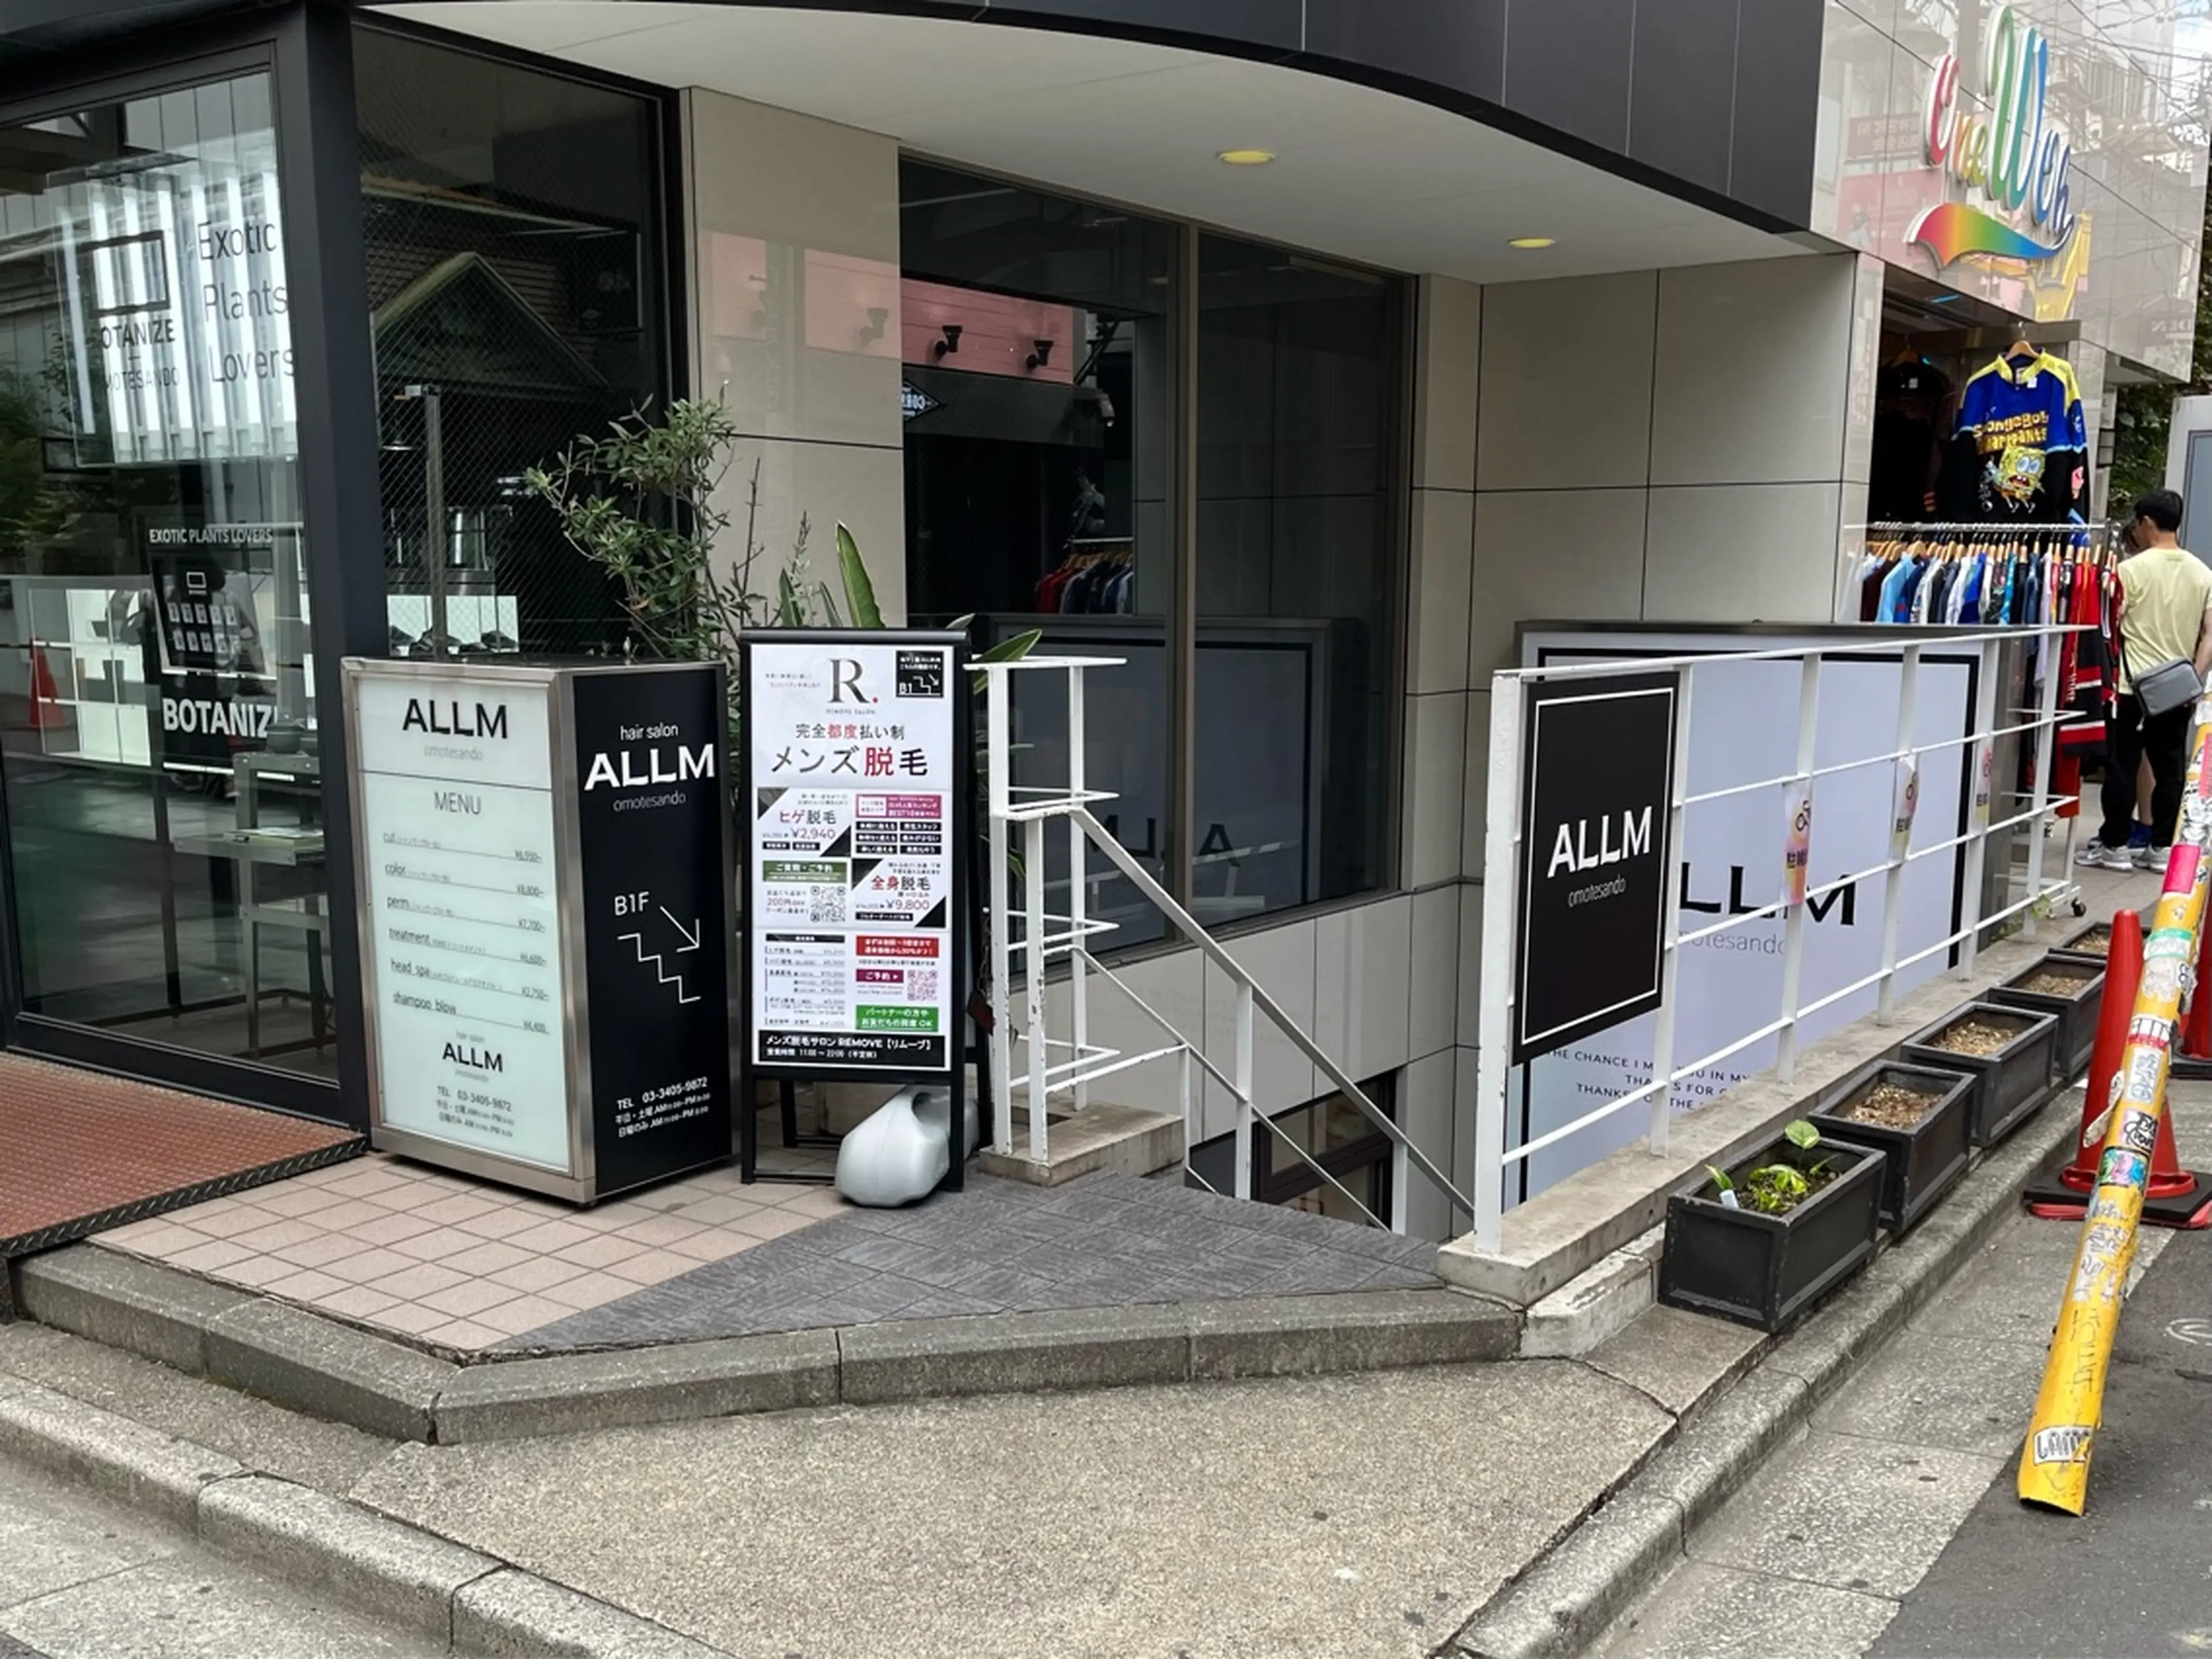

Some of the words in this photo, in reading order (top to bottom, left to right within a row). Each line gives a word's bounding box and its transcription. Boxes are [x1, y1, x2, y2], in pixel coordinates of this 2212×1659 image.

[198, 221, 276, 260] Exotic
[204, 281, 287, 321] Plants
[100, 320, 176, 349] OTANIZE
[209, 344, 294, 382] Lovers
[149, 529, 187, 543] EXOTIC
[188, 529, 229, 543] PLANTS
[231, 529, 273, 543] LOVERS
[899, 682, 912, 694] B1
[162, 698, 278, 738] BOTANIZ
[403, 698, 507, 739] ALLM
[620, 724, 644, 741] hair
[646, 722, 679, 738] salon
[796, 723, 906, 740] 完全都度払い制
[584, 743, 715, 791] ALLM
[771, 745, 928, 777] メンズ脱毛
[434, 791, 481, 815] MENU
[613, 790, 686, 812] omotesando
[780, 809, 836, 825] ヒゲ脱毛
[790, 827, 836, 840] ¥2,940
[1547, 806, 1652, 878] ALLM
[385, 863, 406, 876] color
[871, 874, 931, 891] 全身脱毛
[1568, 874, 1626, 907] omotesando
[387, 896, 410, 909] perm
[614, 891, 649, 915] B1F
[886, 899, 930, 911] ¥9,800
[389, 927, 430, 944] treatment
[391, 958, 412, 974] head
[415, 964, 431, 978] spa
[393, 991, 432, 1010] shampoo
[434, 999, 457, 1014] blow
[766, 1035, 836, 1047] メンズ脱毛サロン
[838, 1037, 883, 1048] REMOVE
[442, 1041, 503, 1073] ALLM
[1574, 1051, 1629, 1068] CHANCE
[1711, 1070, 1725, 1081] IN
[1686, 1083, 1714, 1097] FOR
[616, 1097, 635, 1111] TEL
